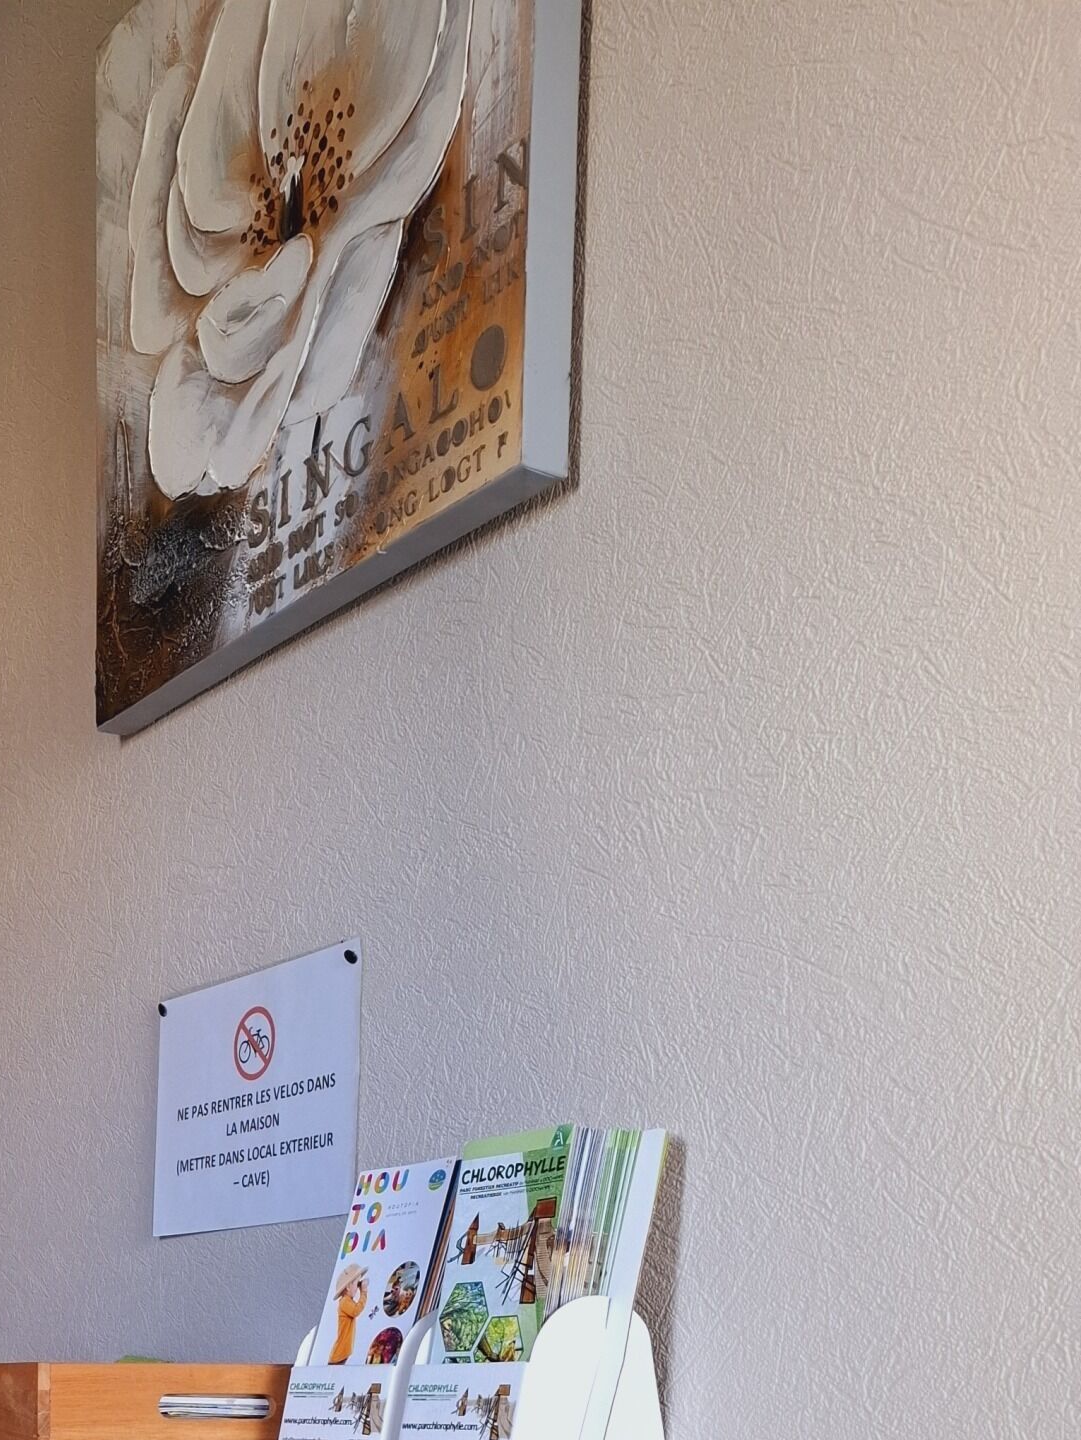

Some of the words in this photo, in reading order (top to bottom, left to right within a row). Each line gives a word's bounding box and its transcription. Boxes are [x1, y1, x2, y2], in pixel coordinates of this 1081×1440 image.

[176, 1108, 190, 1122] NE
[191, 1102, 209, 1119] PAS
[211, 1092, 254, 1115] RENTRER
[255, 1088, 271, 1105] LES
[273, 1080, 305, 1101] VELOS
[307, 1072, 336, 1093] DANS
[226, 1121, 238, 1136] LA
[239, 1113, 281, 1134] MAISON
[176, 1154, 217, 1177] (METTRE
[218, 1148, 245, 1167] DANS
[247, 1143, 278, 1162] LOCAL
[280, 1132, 334, 1156] EXTERIEUR
[241, 1169, 270, 1188] CAVE)
[356, 1168, 410, 1197] HOU
[461, 1155, 567, 1186] CHLOROPHYLLE
[352, 1202, 383, 1226] TO
[289, 1382, 336, 1391] CHLOROPHYLLE
[408, 1383, 460, 1393] CHLOROPHYLLE
